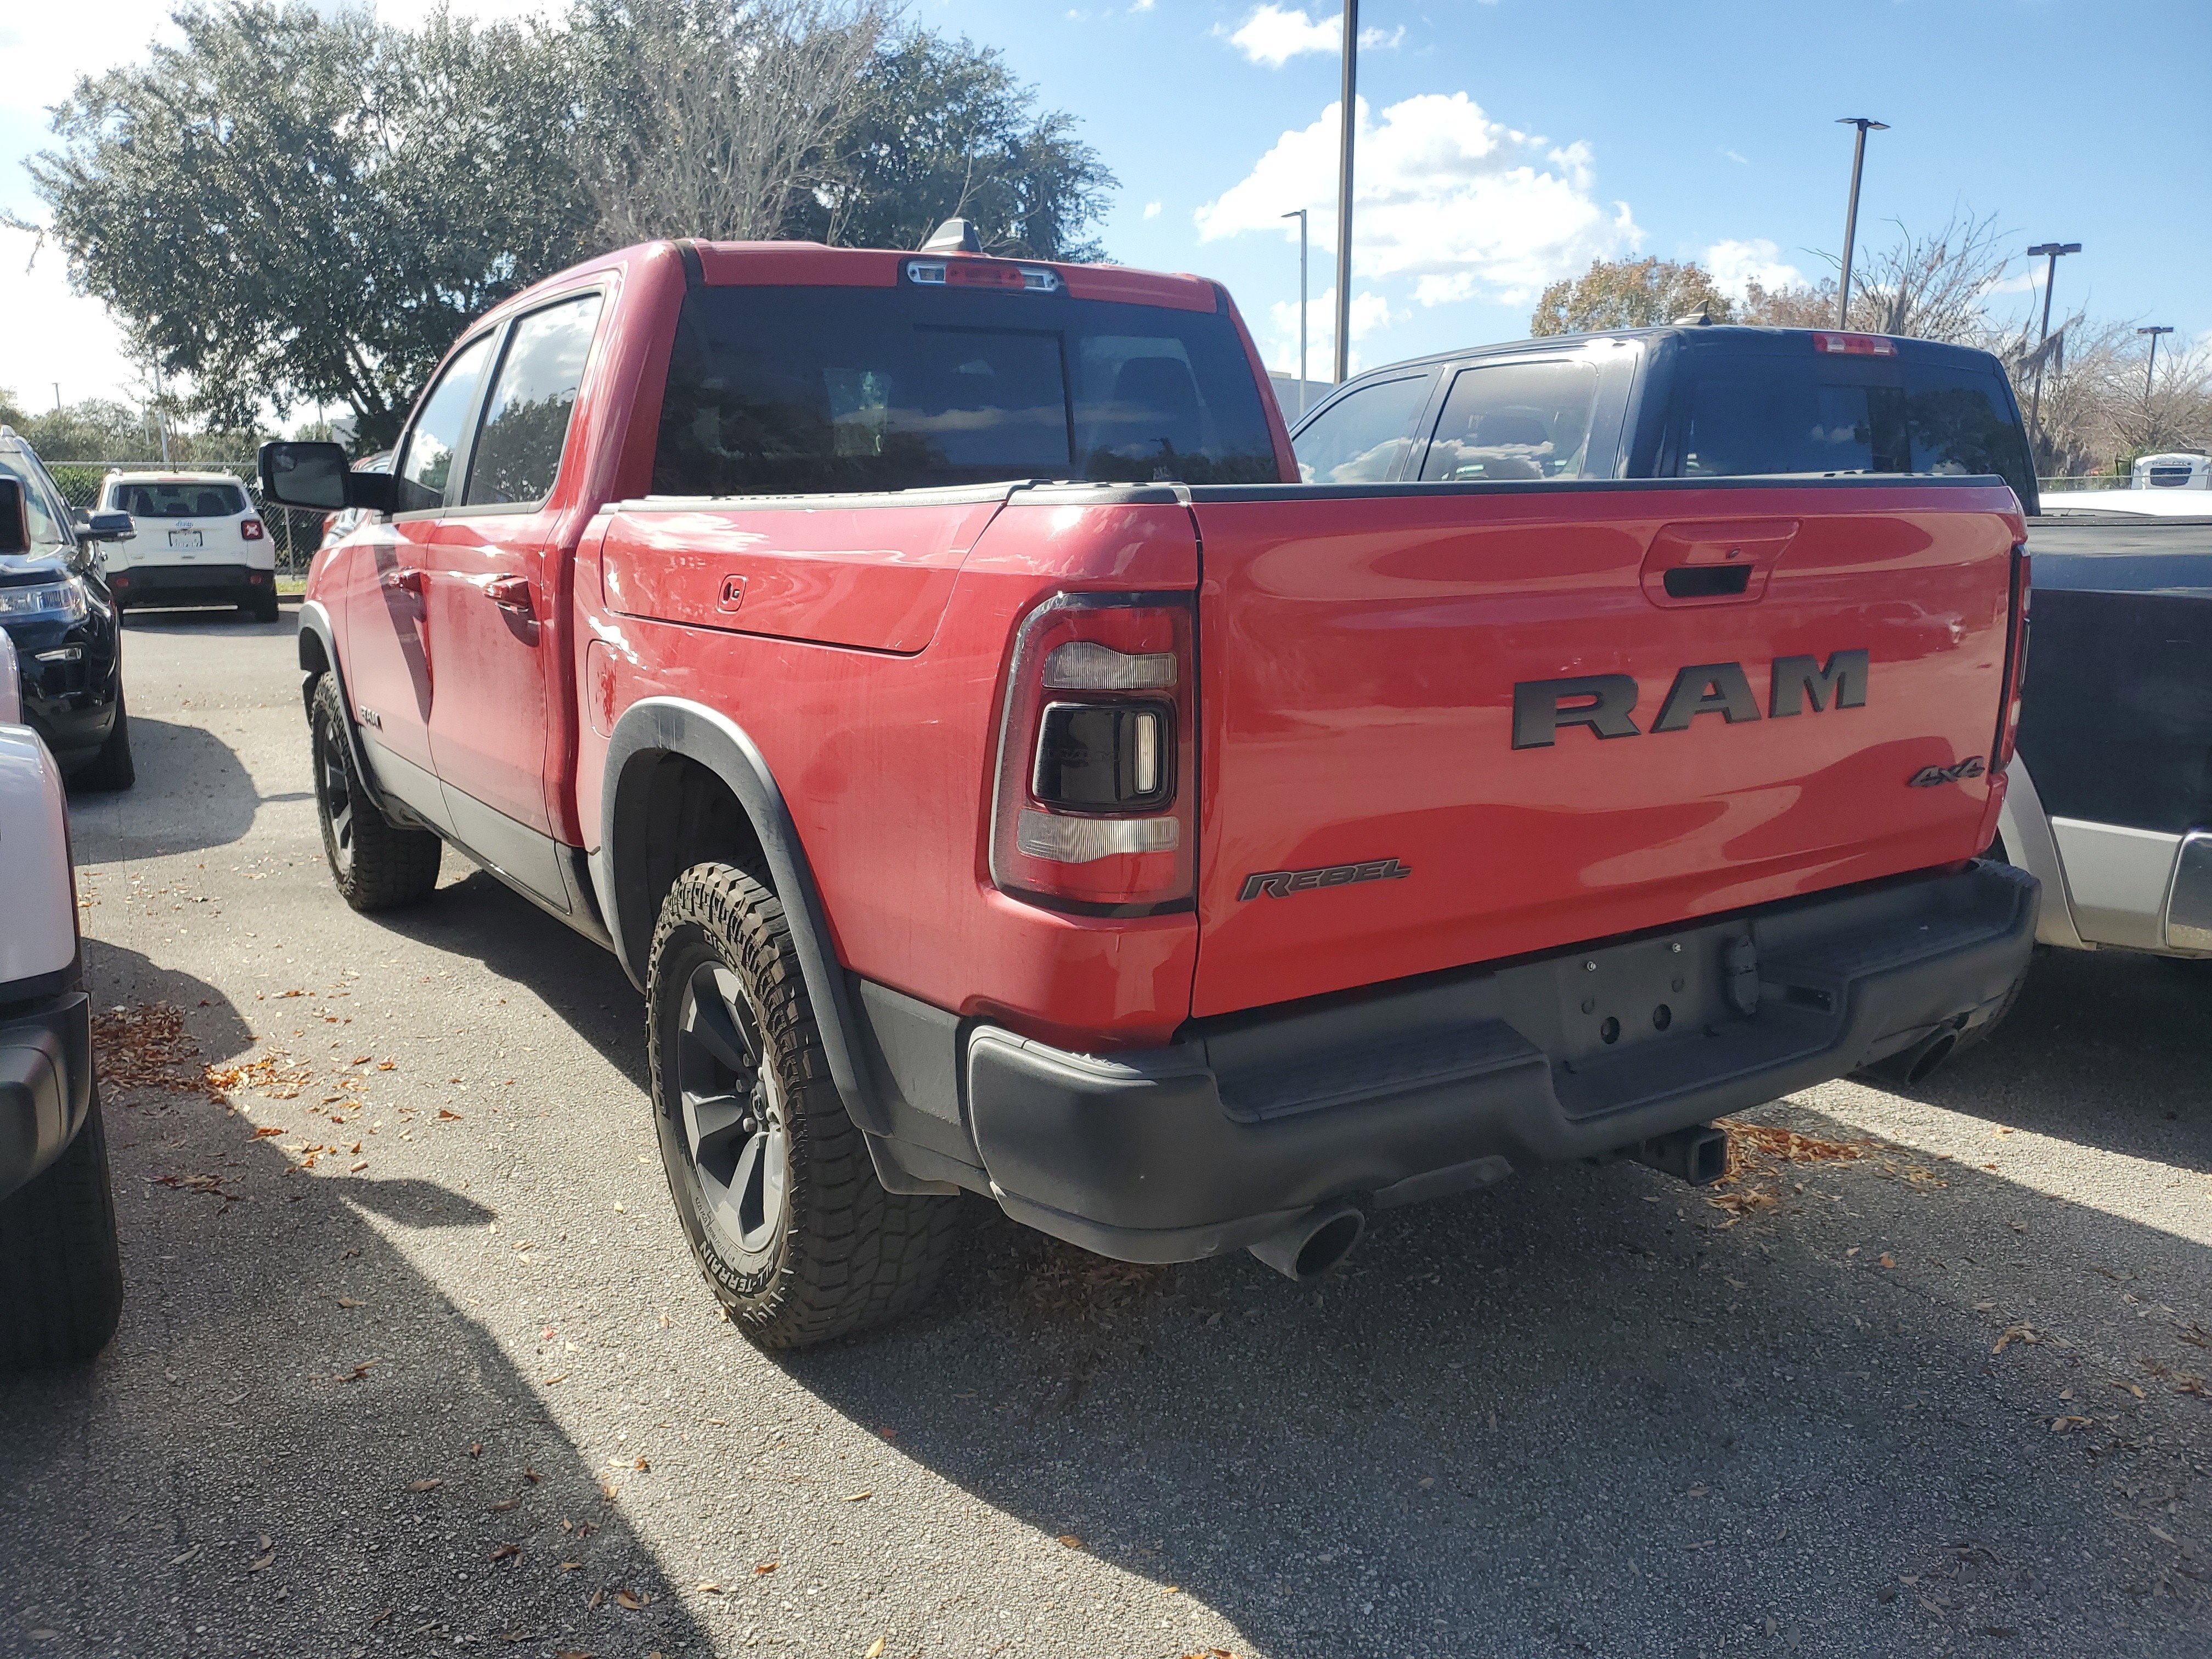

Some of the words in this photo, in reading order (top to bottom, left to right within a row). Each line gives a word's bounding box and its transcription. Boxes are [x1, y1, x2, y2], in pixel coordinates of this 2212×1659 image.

[359, 705, 383, 733] RAM
[1511, 648, 1869, 750] RAM
[1238, 857, 1412, 902] REBEL
[698, 1240, 774, 1294] ALL-TERRAIN
